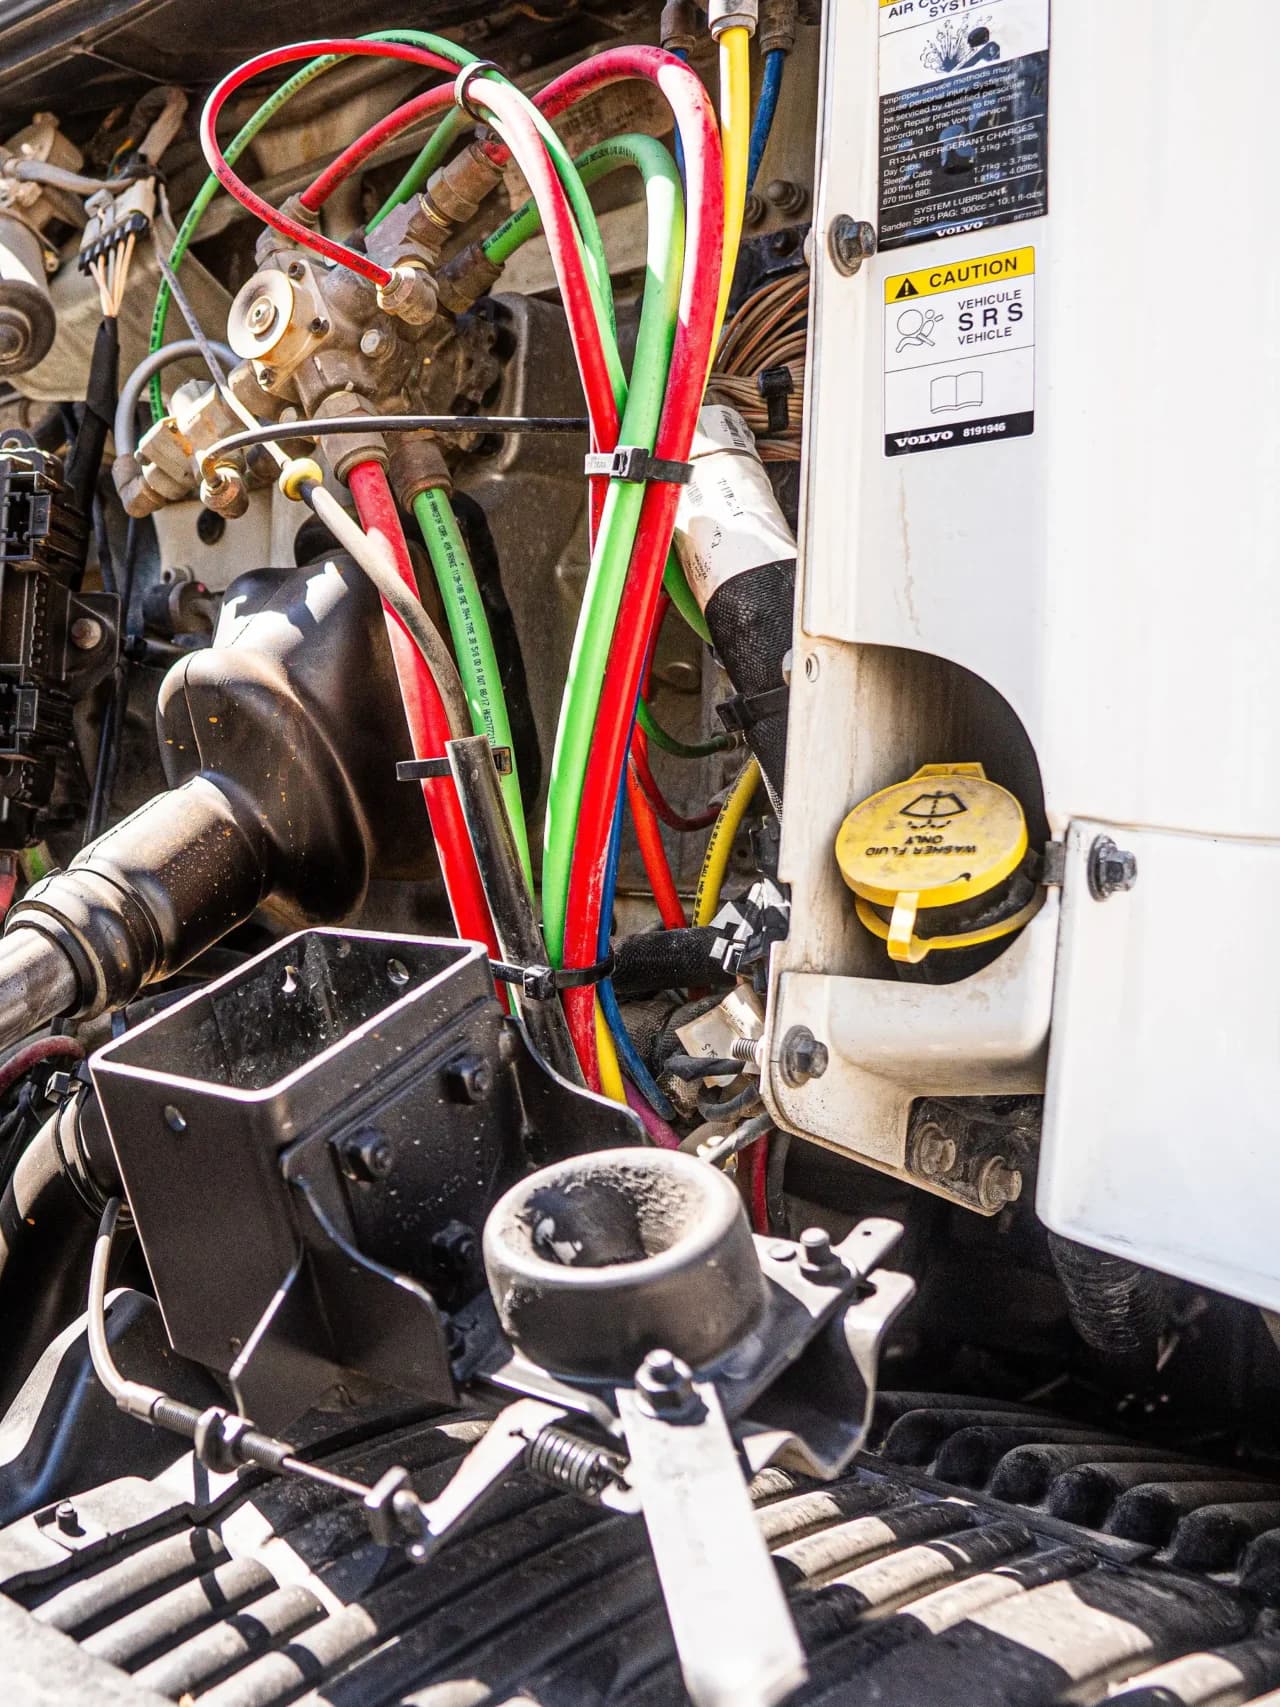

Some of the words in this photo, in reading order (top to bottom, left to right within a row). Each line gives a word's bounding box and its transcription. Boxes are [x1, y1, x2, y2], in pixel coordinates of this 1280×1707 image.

[888, 3, 914, 19] AIR
[884, 90, 918, 105] Improper
[922, 83, 950, 94] service
[953, 70, 990, 85] methods
[993, 66, 1010, 76] may
[883, 103, 906, 114] cause
[909, 92, 944, 107] personal
[896, 106, 929, 120] serviced
[932, 103, 941, 111] by
[944, 92, 979, 108] qualified
[883, 127, 923, 143] according
[951, 114, 974, 124] Volvo
[976, 107, 1006, 118] service
[884, 124, 901, 133] only.
[904, 116, 929, 129] Repair
[932, 105, 971, 121] practices
[889, 153, 916, 165] R134A
[919, 136, 983, 158] REFRIGERANT
[986, 123, 1034, 140] CHARGES
[883, 168, 897, 177] Day
[974, 162, 999, 174] 1.71kg
[883, 175, 909, 187] Sleeper
[912, 169, 932, 178] Cabs
[898, 183, 913, 191] thru
[898, 192, 913, 200] thru
[914, 201, 950, 215] SYSTEM
[953, 187, 1007, 205] LUBRICANT
[881, 220, 911, 232] Sanden
[913, 214, 935, 224] SP15
[937, 209, 957, 219] PAG:
[960, 202, 986, 213] 300cc
[997, 195, 1015, 205] 10.1
[936, 220, 983, 237] VOLVO
[929, 256, 1018, 288] CAUTION
[958, 289, 1022, 311] VEHICULE
[958, 326, 1012, 346] VEHICLE
[894, 430, 954, 448] VOLVO
[464, 621, 475, 635] TYPE
[904, 835, 944, 844] ONLY
[865, 846, 906, 857] FLUID
[912, 845, 977, 856] WASHER
